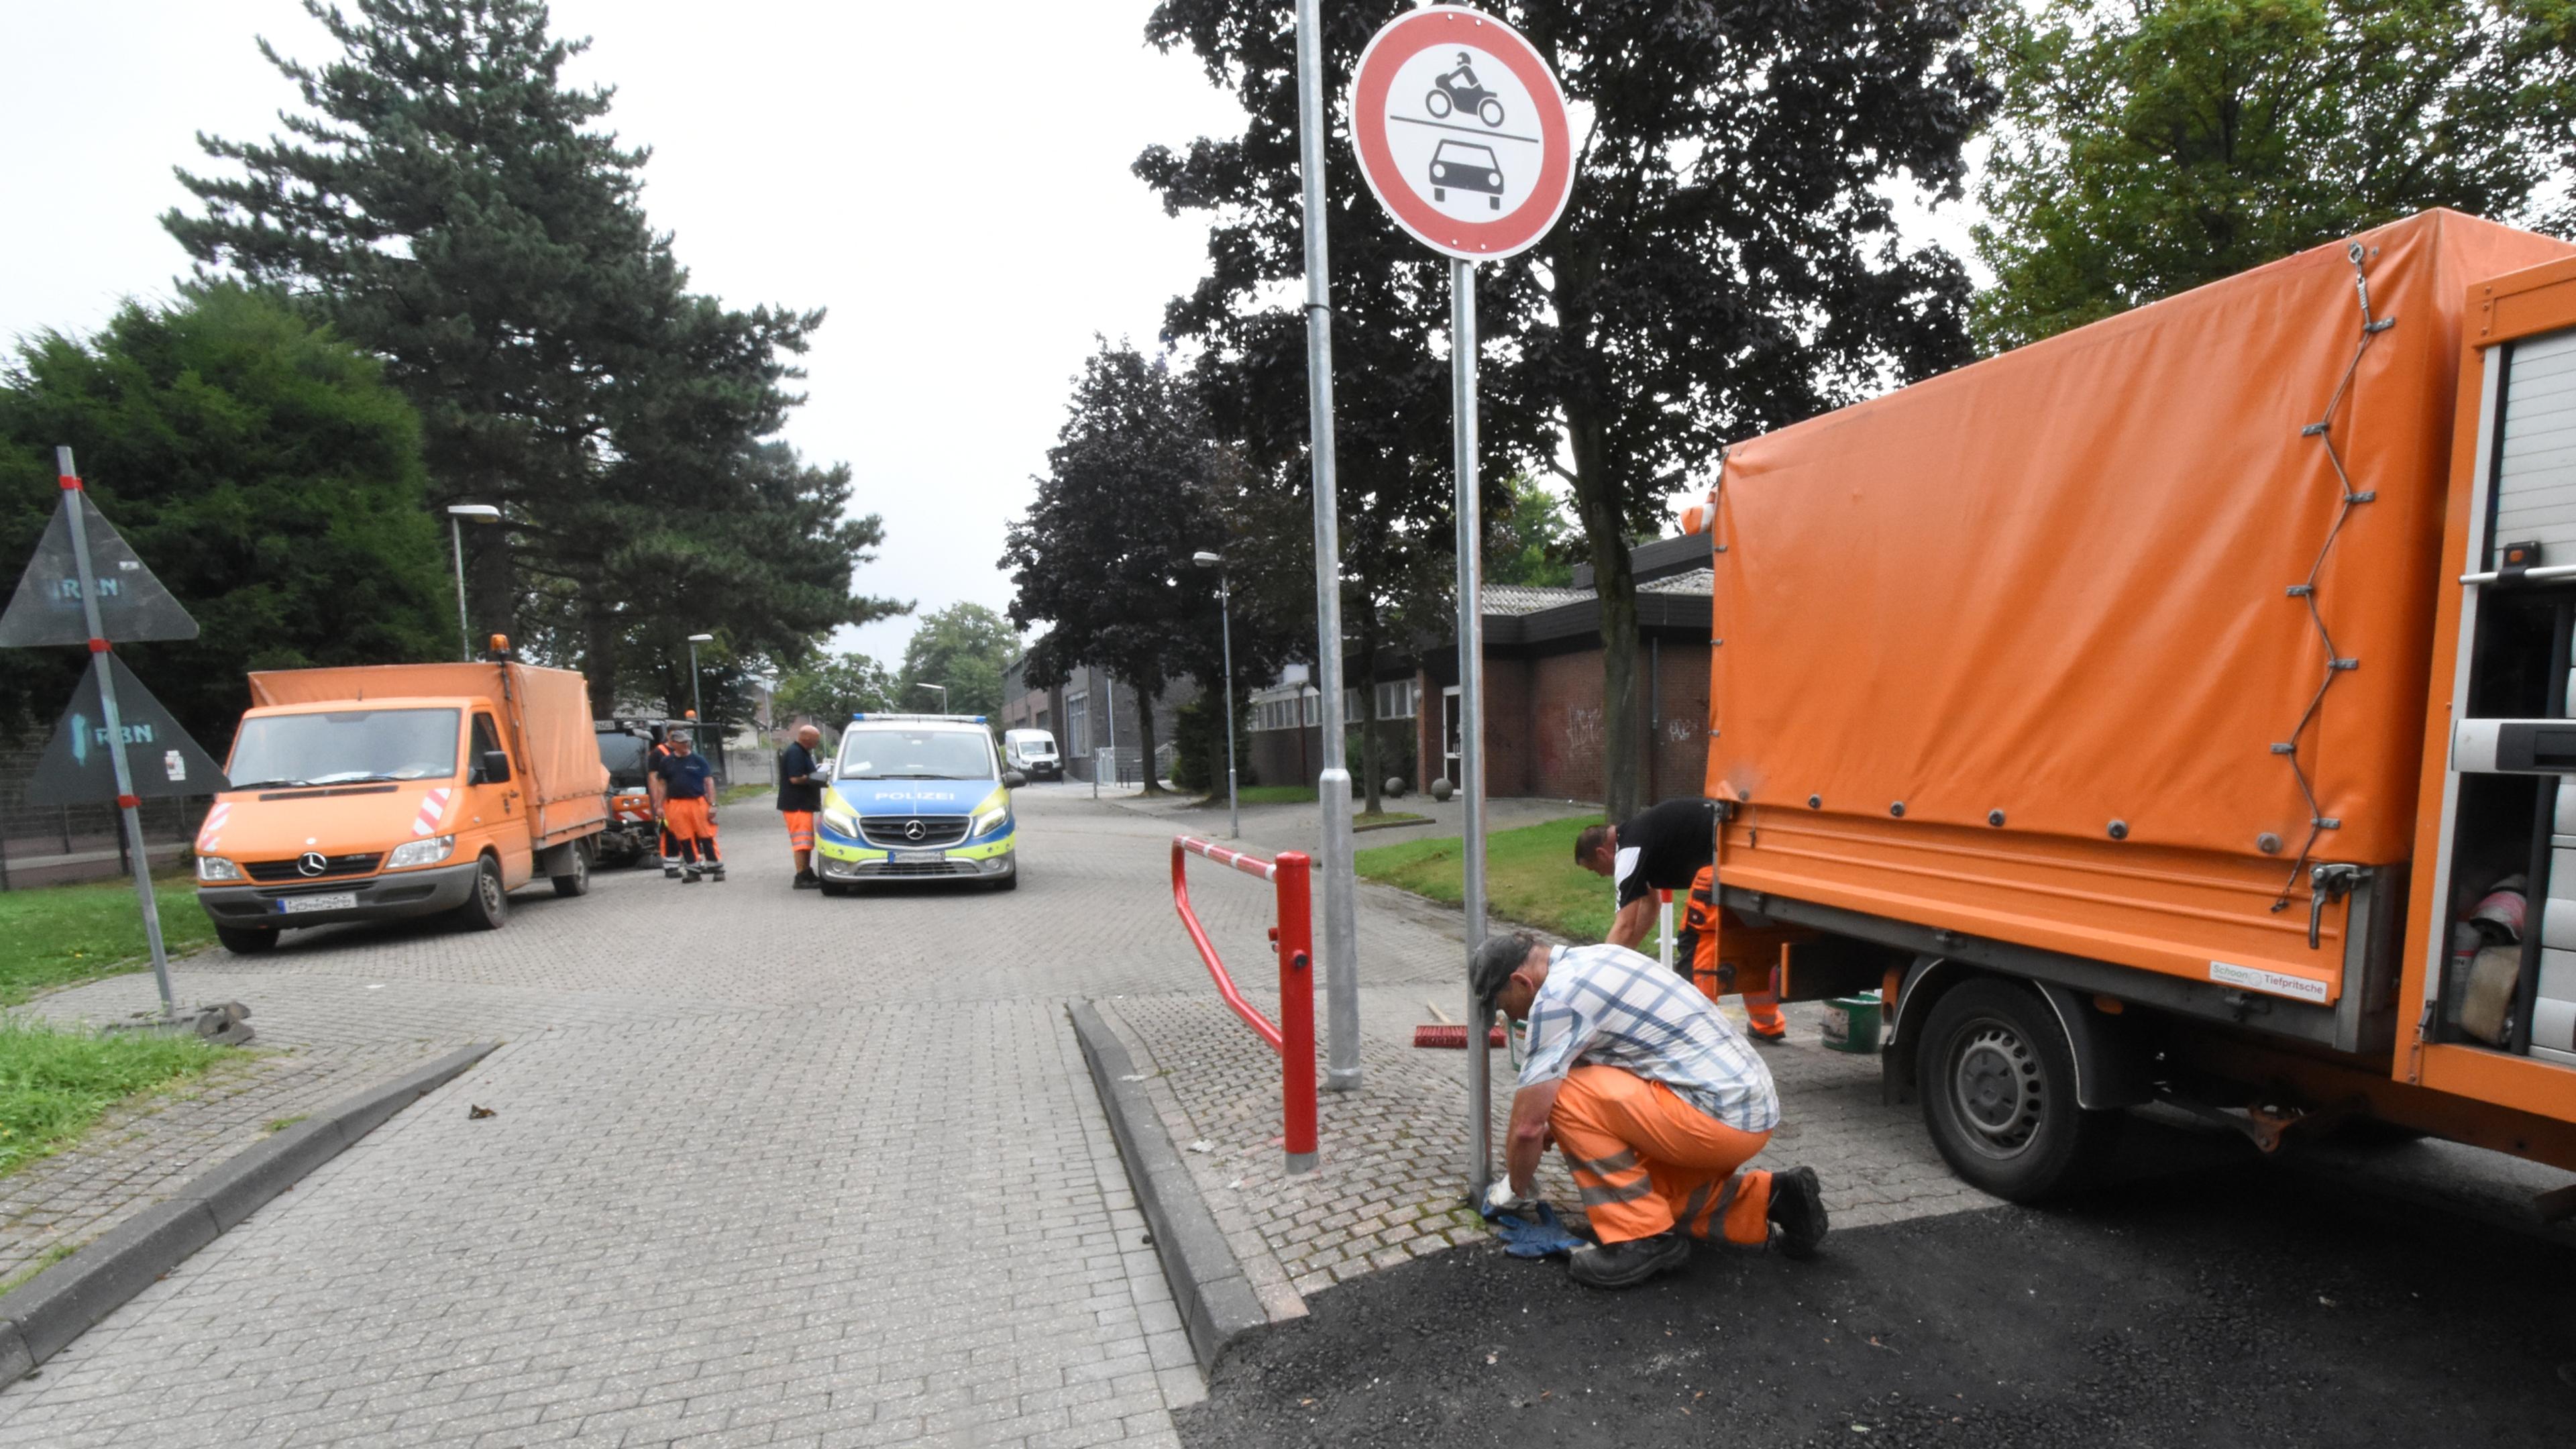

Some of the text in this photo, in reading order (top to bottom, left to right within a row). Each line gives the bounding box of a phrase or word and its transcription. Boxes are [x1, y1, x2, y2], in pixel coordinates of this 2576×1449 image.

[62, 578, 118, 598] RN
[875, 792, 955, 800] POLIZEI
[2213, 965, 2323, 994] Schoon Tiefpritsche
